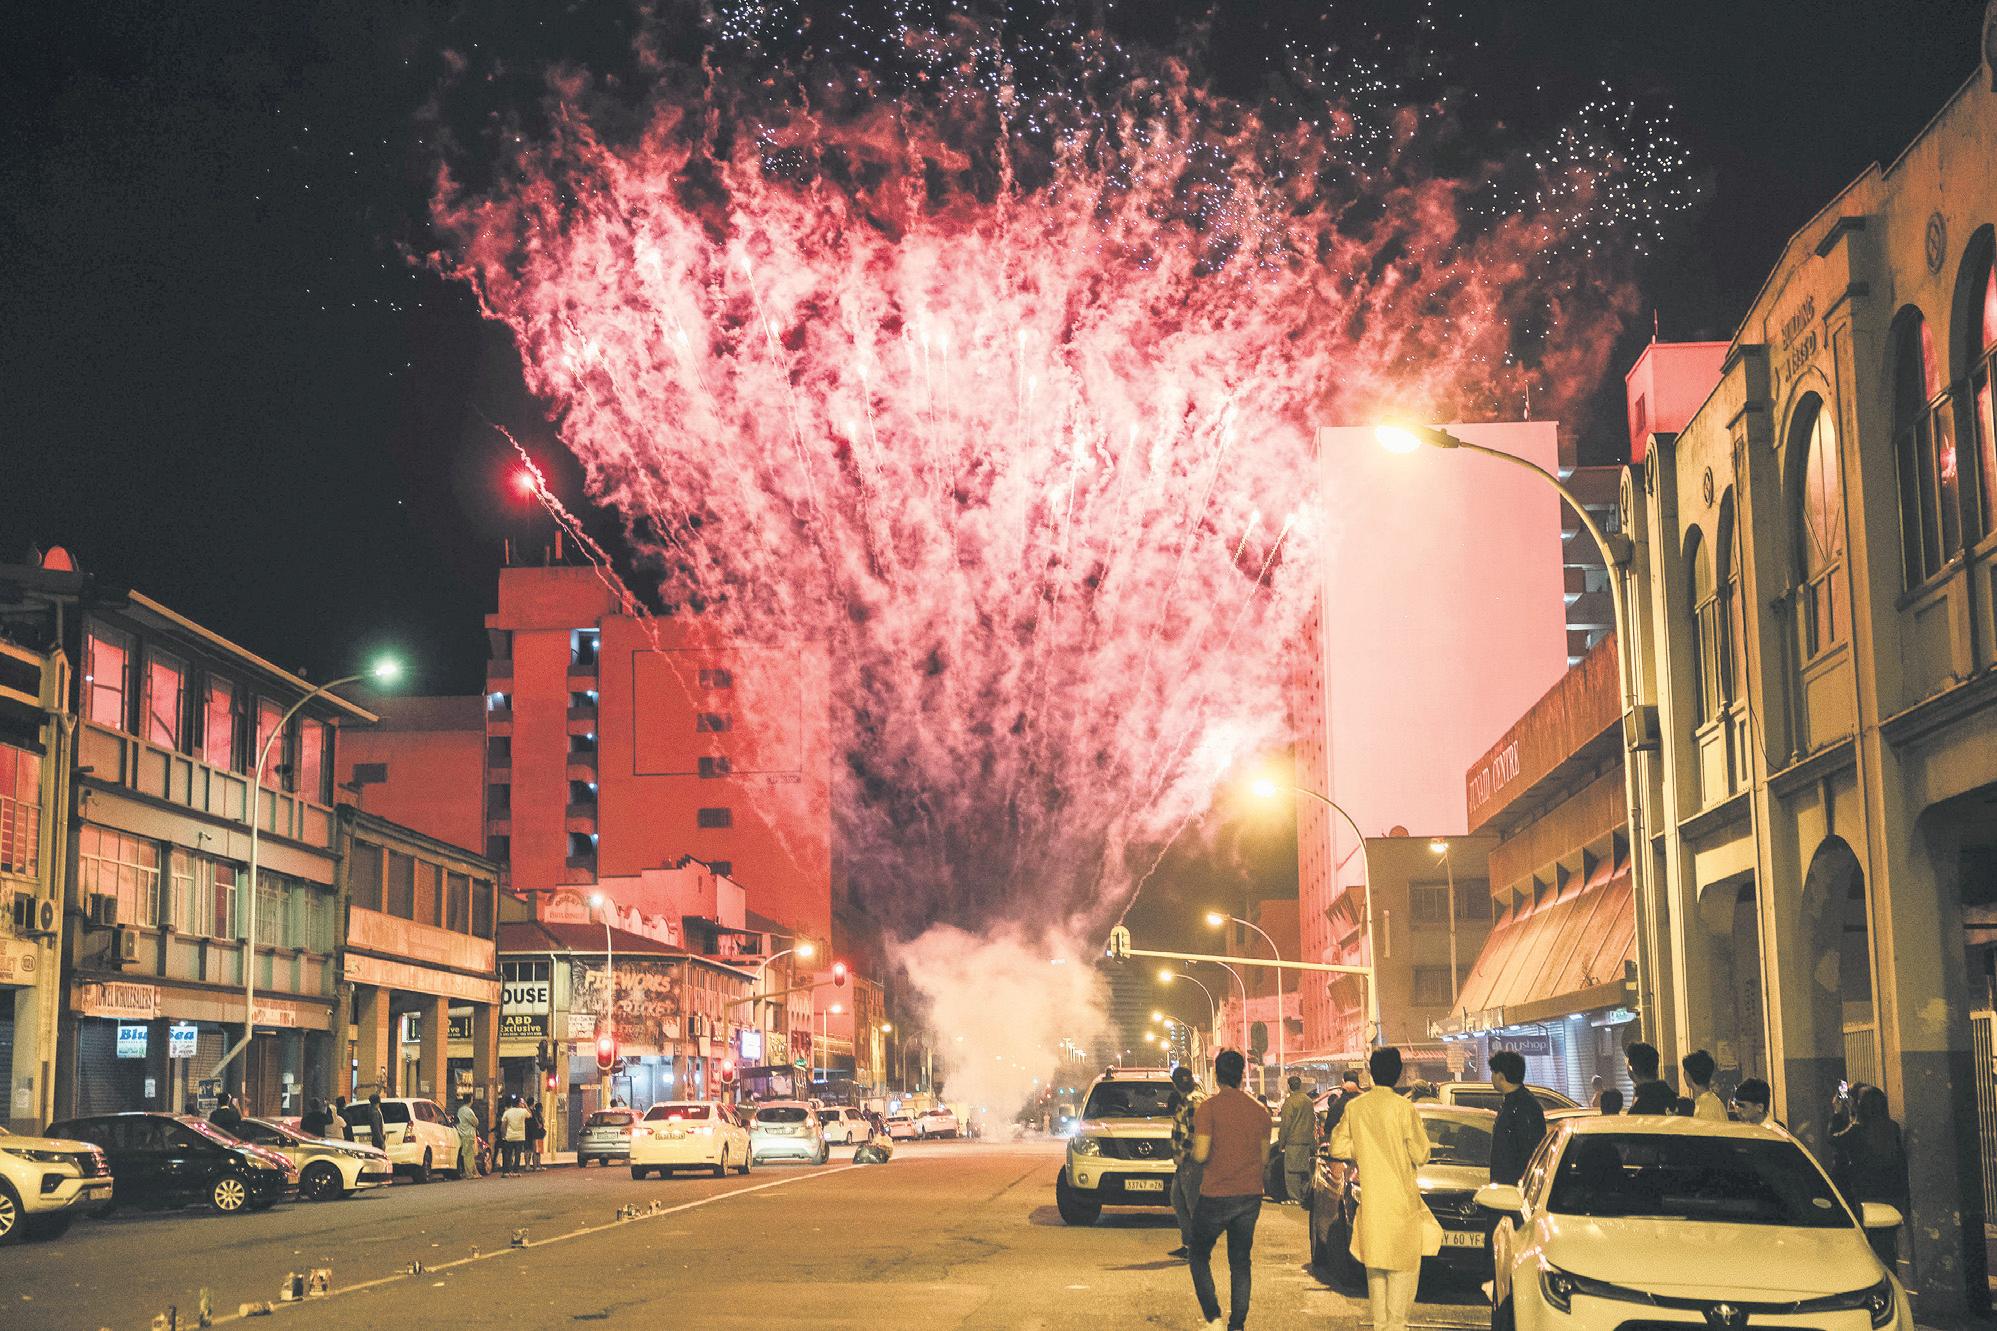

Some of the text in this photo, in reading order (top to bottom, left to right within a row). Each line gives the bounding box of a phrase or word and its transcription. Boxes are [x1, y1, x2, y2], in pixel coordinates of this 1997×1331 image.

[1493, 740, 1520, 793] CENTRE
[502, 987, 547, 1005] OUSE
[506, 1016, 532, 1025] ABD
[119, 1028, 148, 1041] Blu
[1453, 1232, 1465, 1245] 60
